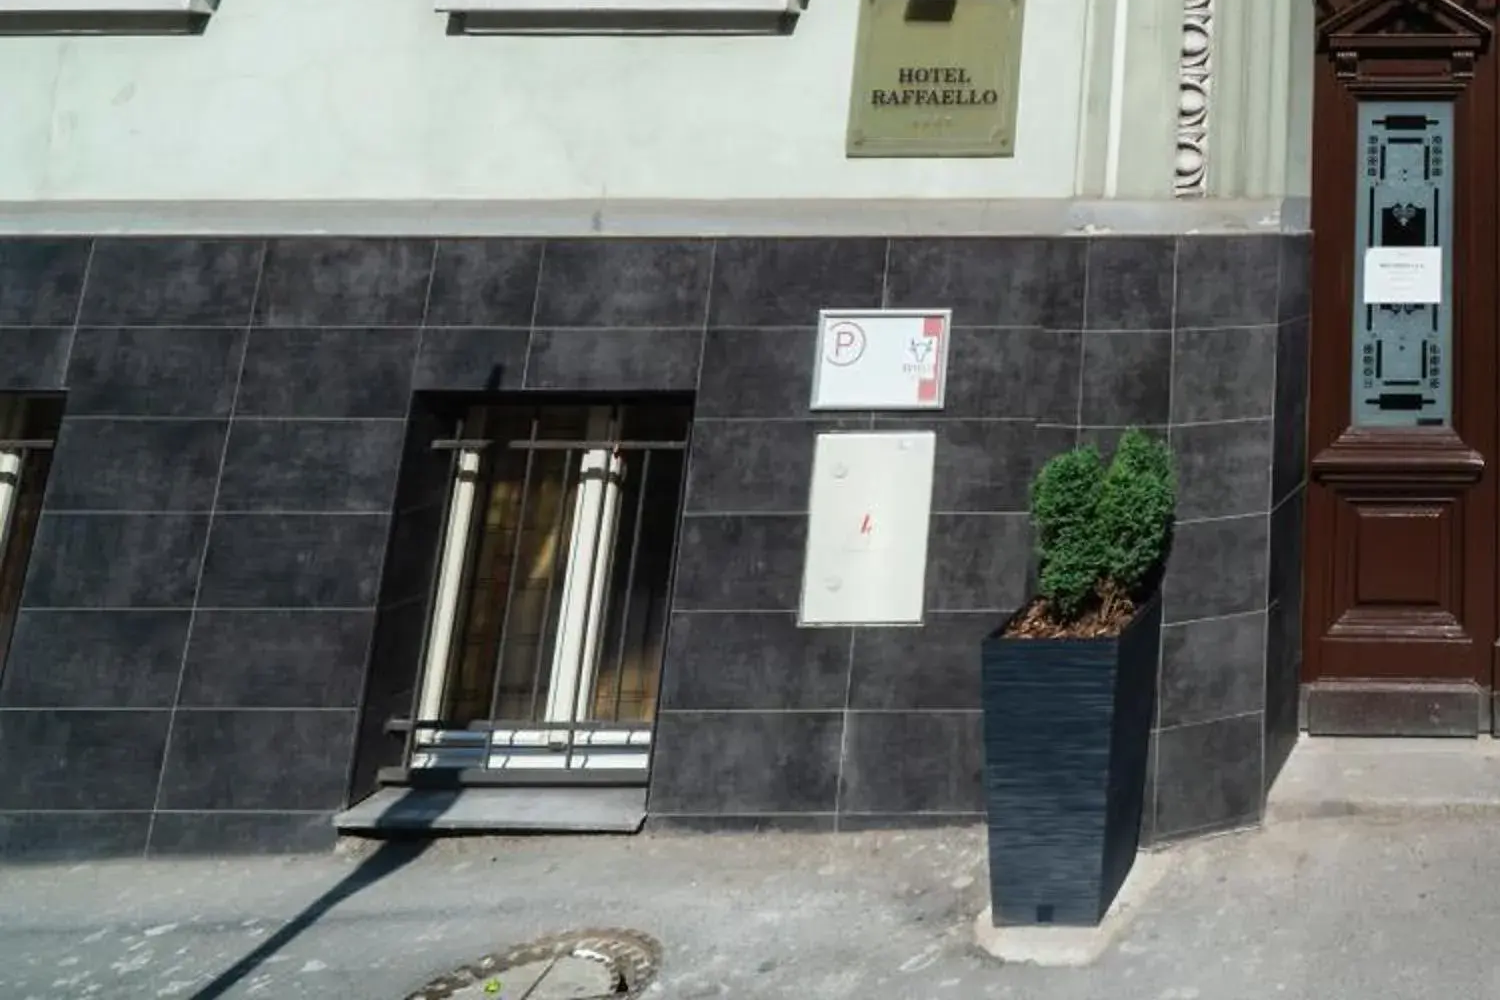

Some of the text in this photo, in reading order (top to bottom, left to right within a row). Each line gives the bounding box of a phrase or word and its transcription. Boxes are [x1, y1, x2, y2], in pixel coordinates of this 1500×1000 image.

[898, 67, 971, 84] HOTEL
[871, 89, 998, 106] RAFFAELLO
[835, 331, 855, 357] P
